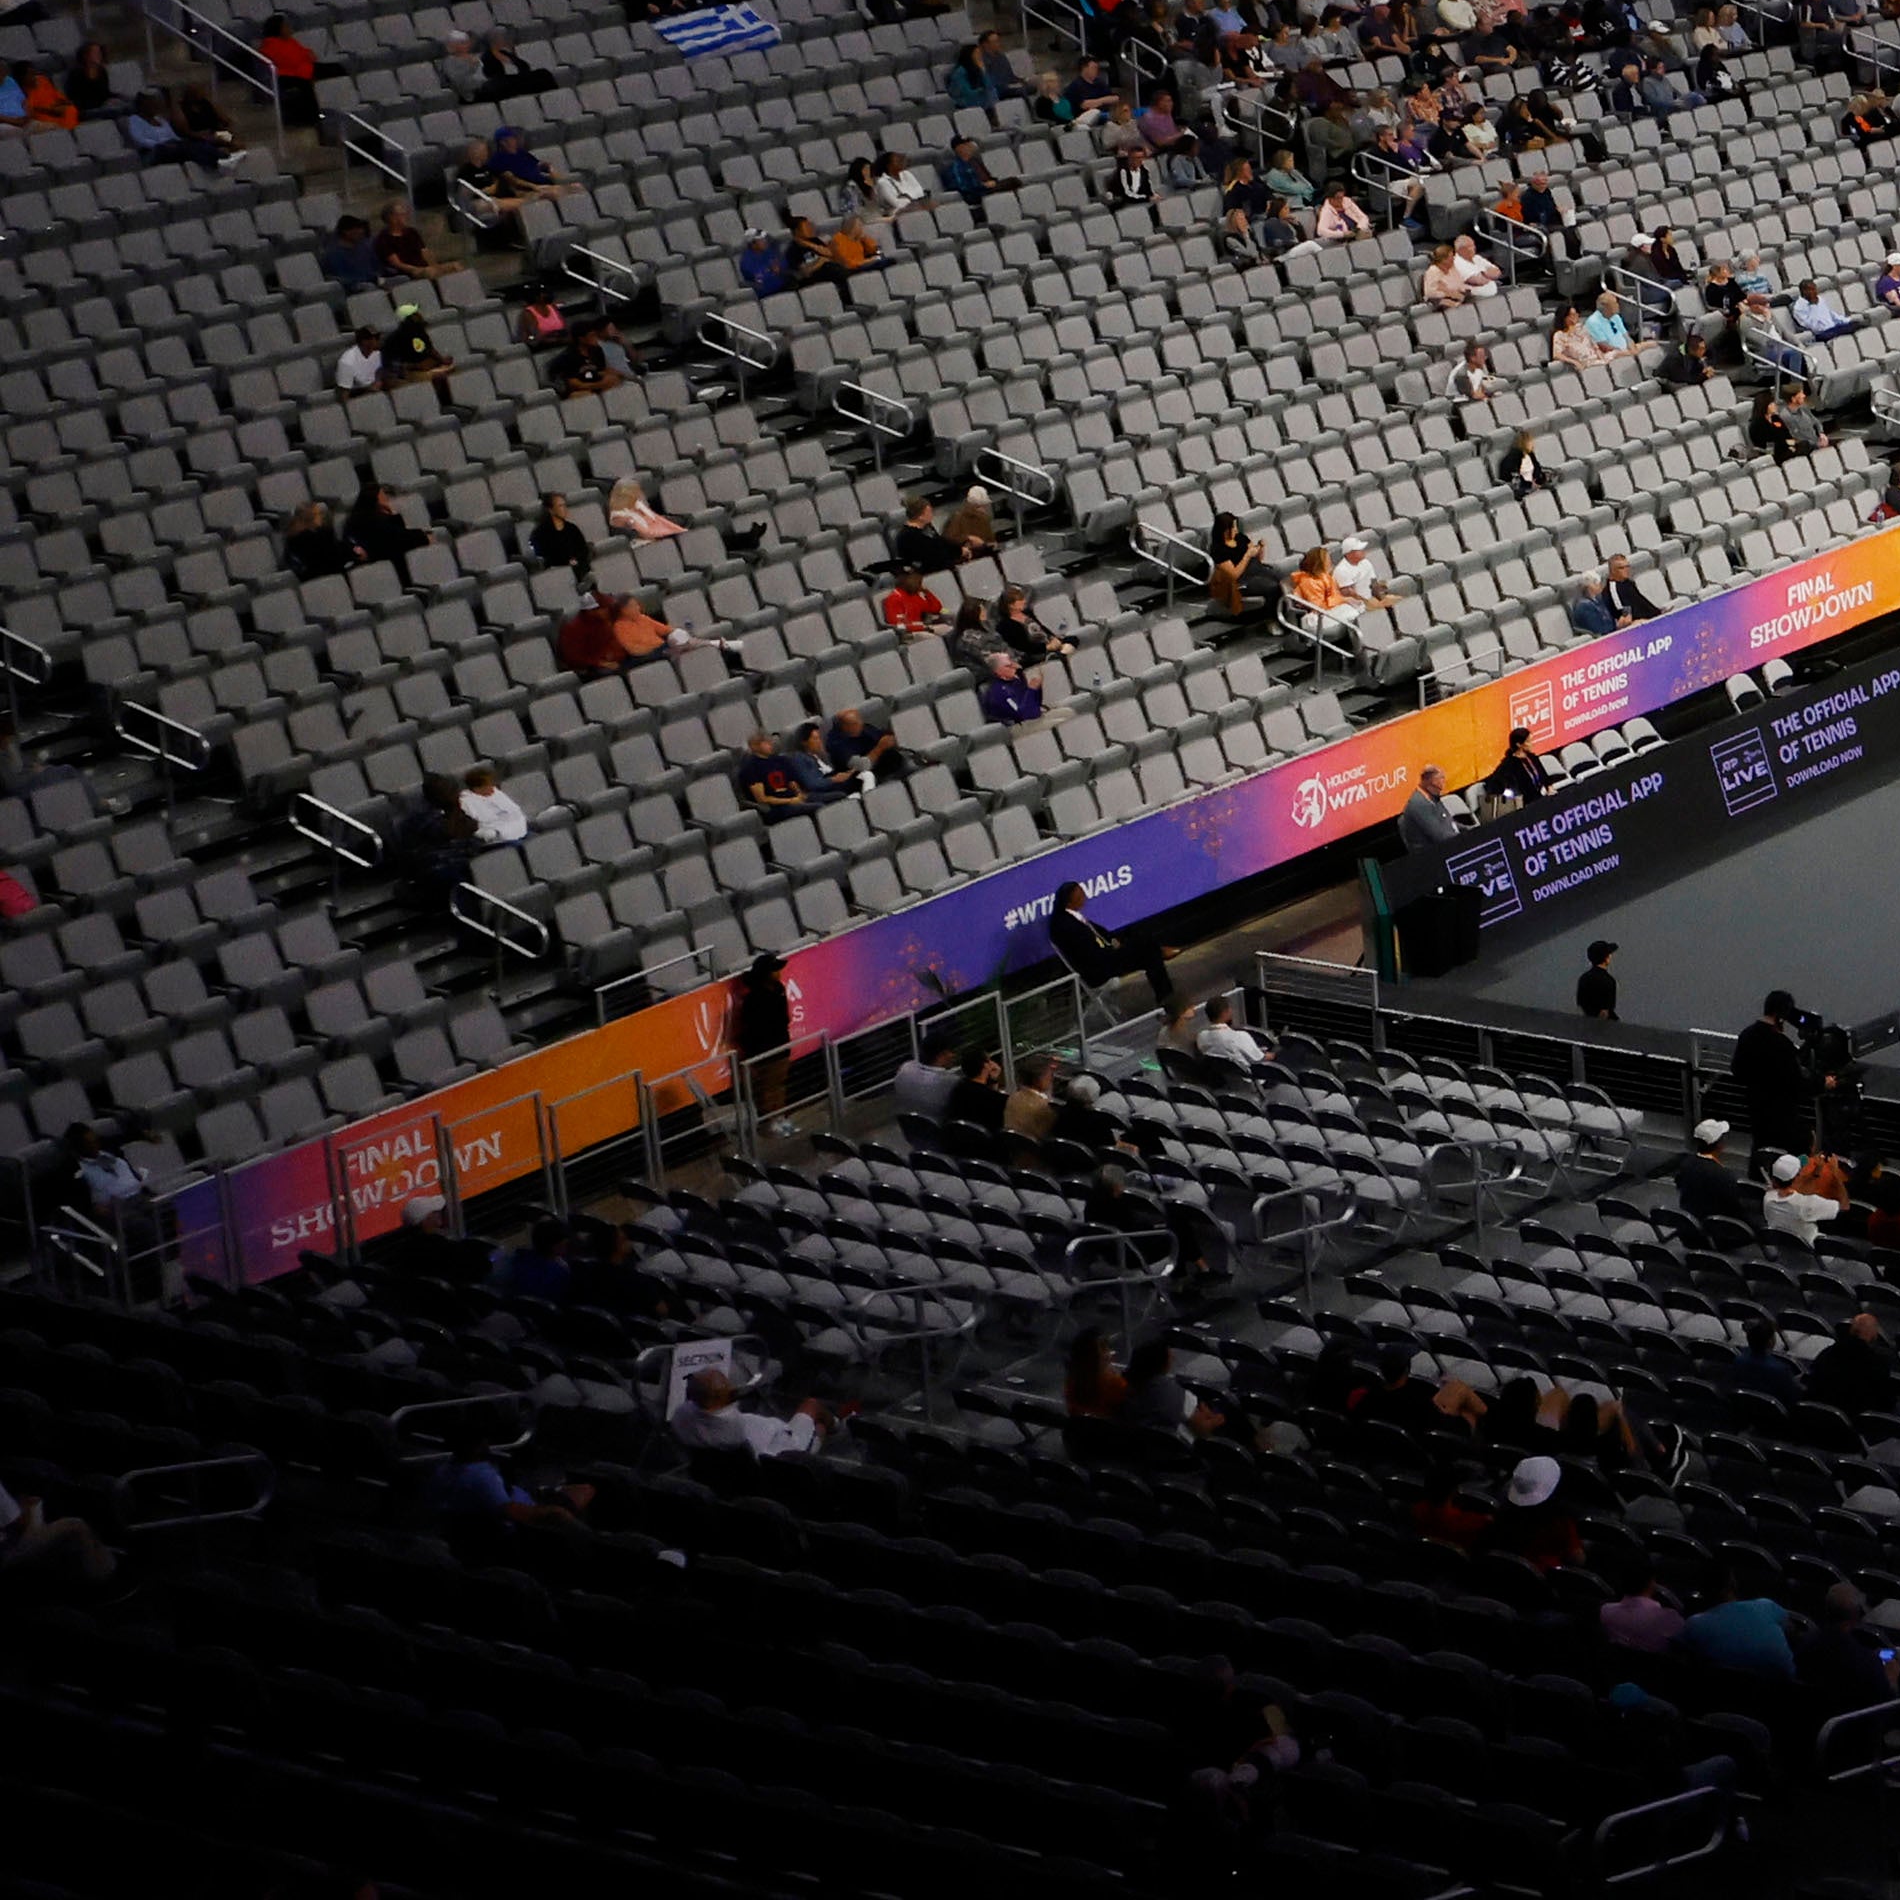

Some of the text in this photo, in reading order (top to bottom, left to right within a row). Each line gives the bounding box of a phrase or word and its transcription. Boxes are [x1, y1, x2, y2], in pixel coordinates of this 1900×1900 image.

[1787, 571, 1834, 607] FINAL
[1750, 581, 1874, 649] SHOWDOWN
[1560, 636, 1672, 691] THE OFFICIAL APP
[1562, 673, 1628, 711] OF TENNIS
[1771, 669, 1900, 740] THE OFFICIAL APP
[1513, 707, 1550, 729] LIVE
[1779, 716, 1857, 764] OF TENNIS
[1326, 764, 1367, 787] HOLOGIC
[1722, 761, 1768, 791] LIVE
[1786, 745, 1864, 788] DOWNLOAD NOW
[1515, 773, 1663, 851] THE OFFICIAL APP
[1525, 823, 1613, 878] OF TENNIS
[1533, 853, 1620, 902] DOWNLOAD NOW
[346, 1128, 432, 1177] FINAL
